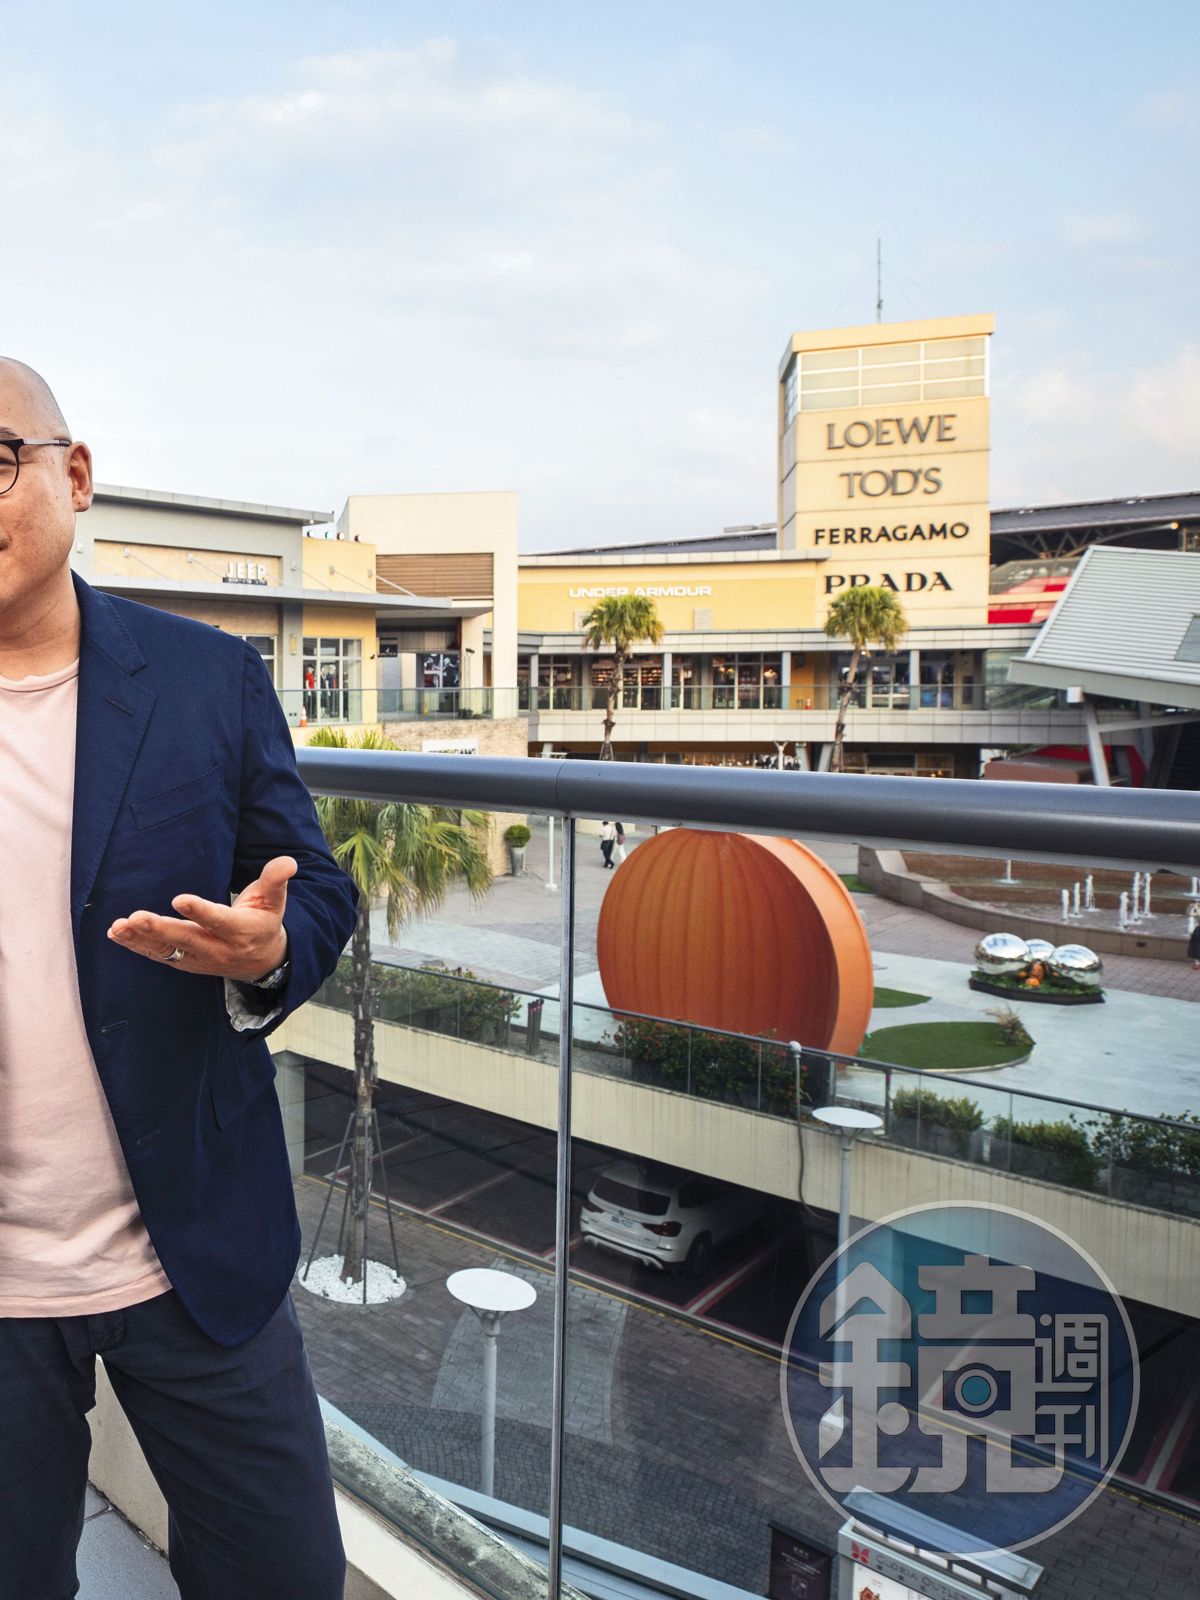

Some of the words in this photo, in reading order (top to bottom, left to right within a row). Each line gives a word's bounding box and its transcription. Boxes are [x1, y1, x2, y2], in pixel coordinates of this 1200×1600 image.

[827, 414, 958, 450] LOEWE
[839, 466, 943, 499] TOD'S
[814, 522, 970, 545] FERRAGAMO
[569, 586, 628, 598] UNDER
[634, 585, 712, 597] ARMOUR
[824, 571, 954, 594] PRADA
